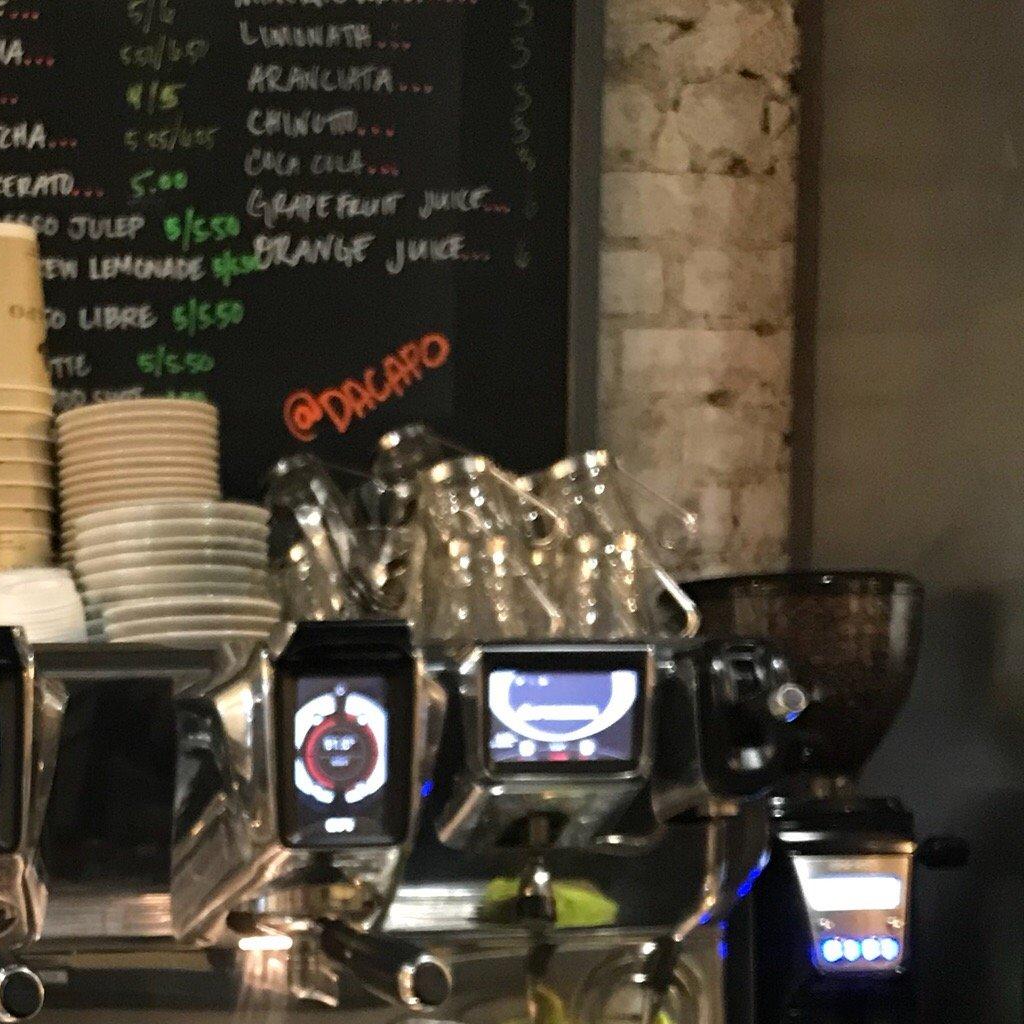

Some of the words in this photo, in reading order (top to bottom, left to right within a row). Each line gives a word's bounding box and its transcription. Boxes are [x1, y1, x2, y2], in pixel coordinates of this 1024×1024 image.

[67, 214, 146, 241] JULEP
[88, 253, 207, 283] LEMONADE
[77, 303, 159, 332] LIBRE
